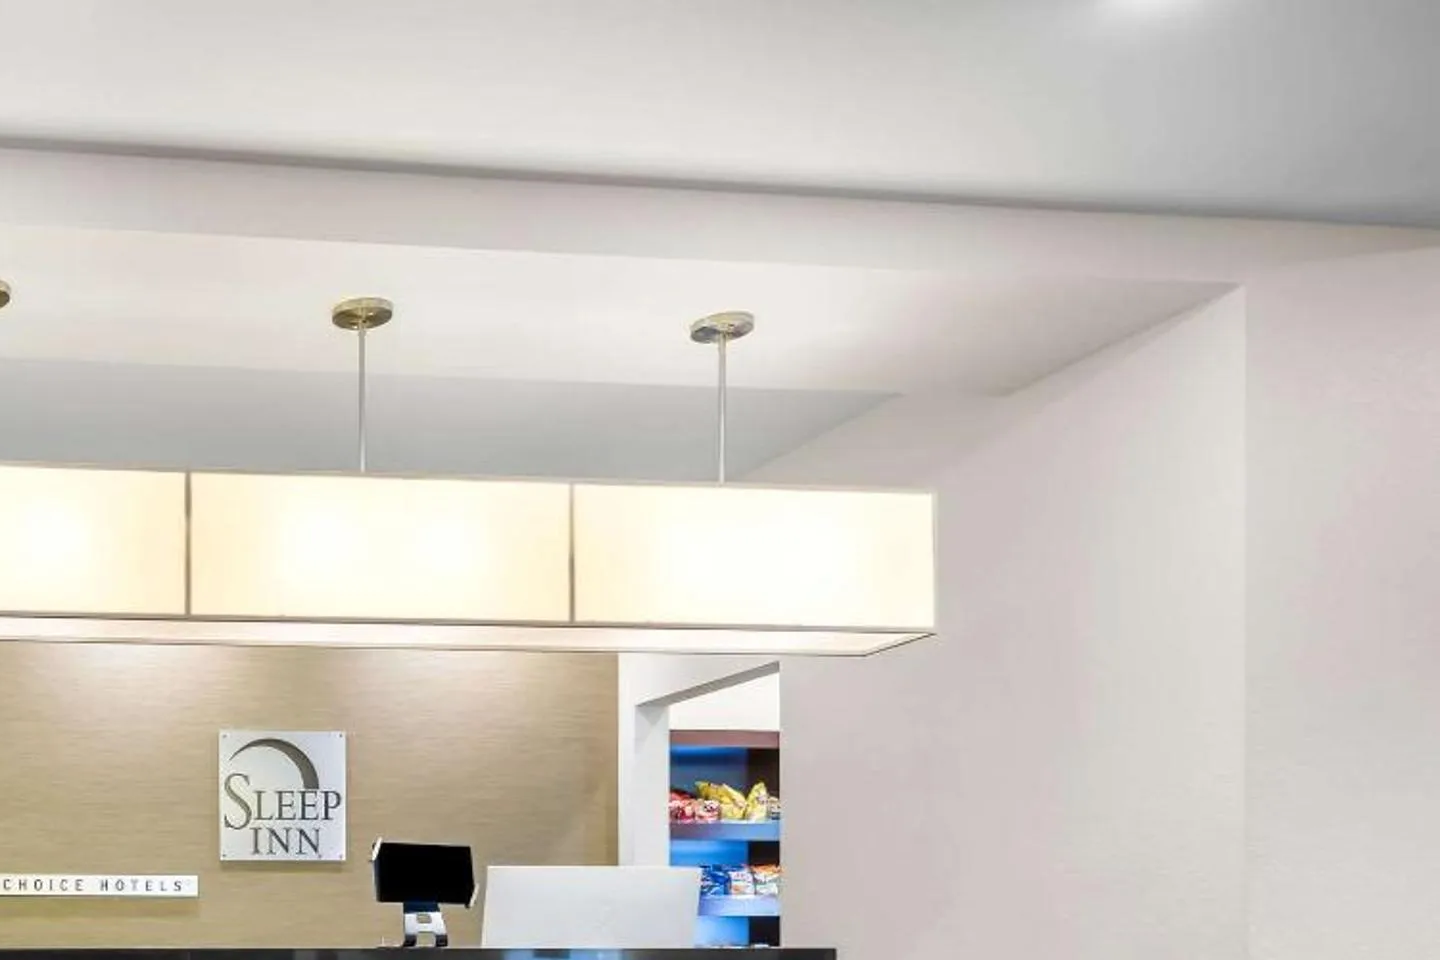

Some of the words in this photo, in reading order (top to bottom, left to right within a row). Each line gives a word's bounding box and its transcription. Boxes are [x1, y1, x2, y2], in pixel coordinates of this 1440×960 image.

[224, 773, 342, 830] SLEEP
[249, 827, 320, 857] INN
[3, 879, 84, 891] CHOICE
[100, 879, 182, 892] HOTELS
